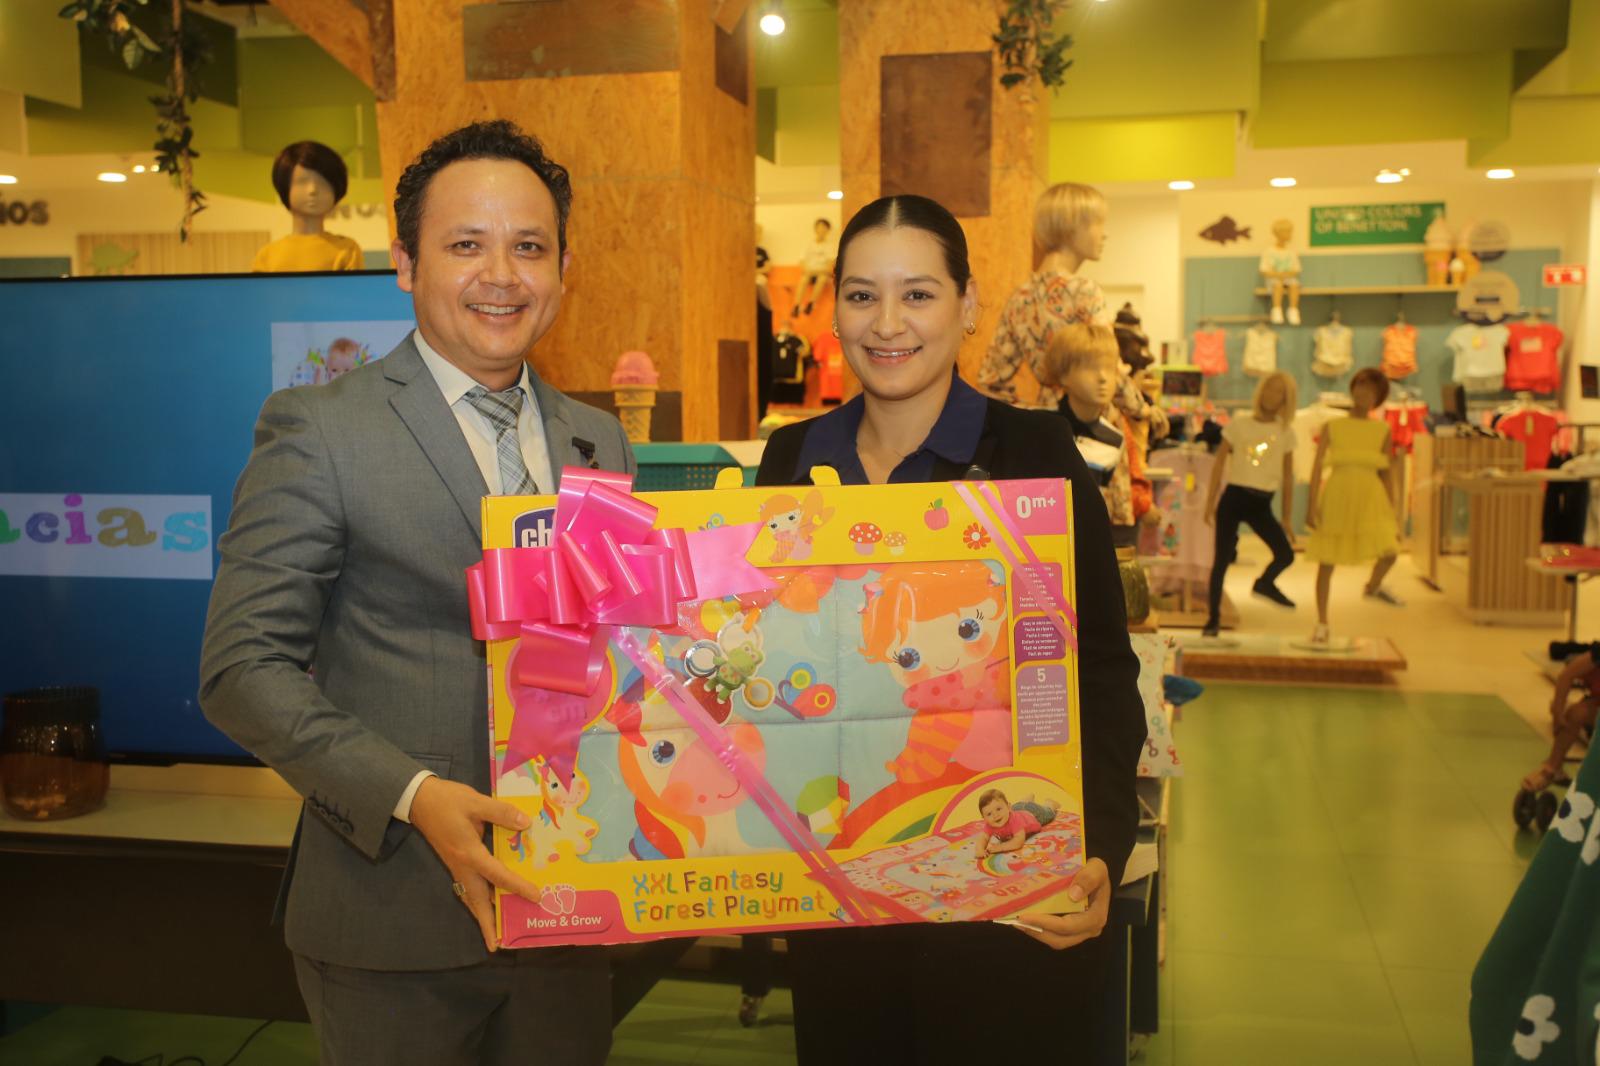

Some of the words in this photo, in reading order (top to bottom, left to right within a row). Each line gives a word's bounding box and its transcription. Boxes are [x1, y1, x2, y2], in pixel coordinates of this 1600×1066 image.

[0, 200, 49, 226] OS
[1036, 667, 1047, 683] 5
[632, 872, 678, 897] XXL
[683, 868, 784, 894] Fantasy
[633, 896, 717, 923] Forest
[724, 889, 826, 919] Playmat
[526, 917, 557, 929] Move
[559, 915, 569, 927] &
[571, 915, 602, 926] Grow
